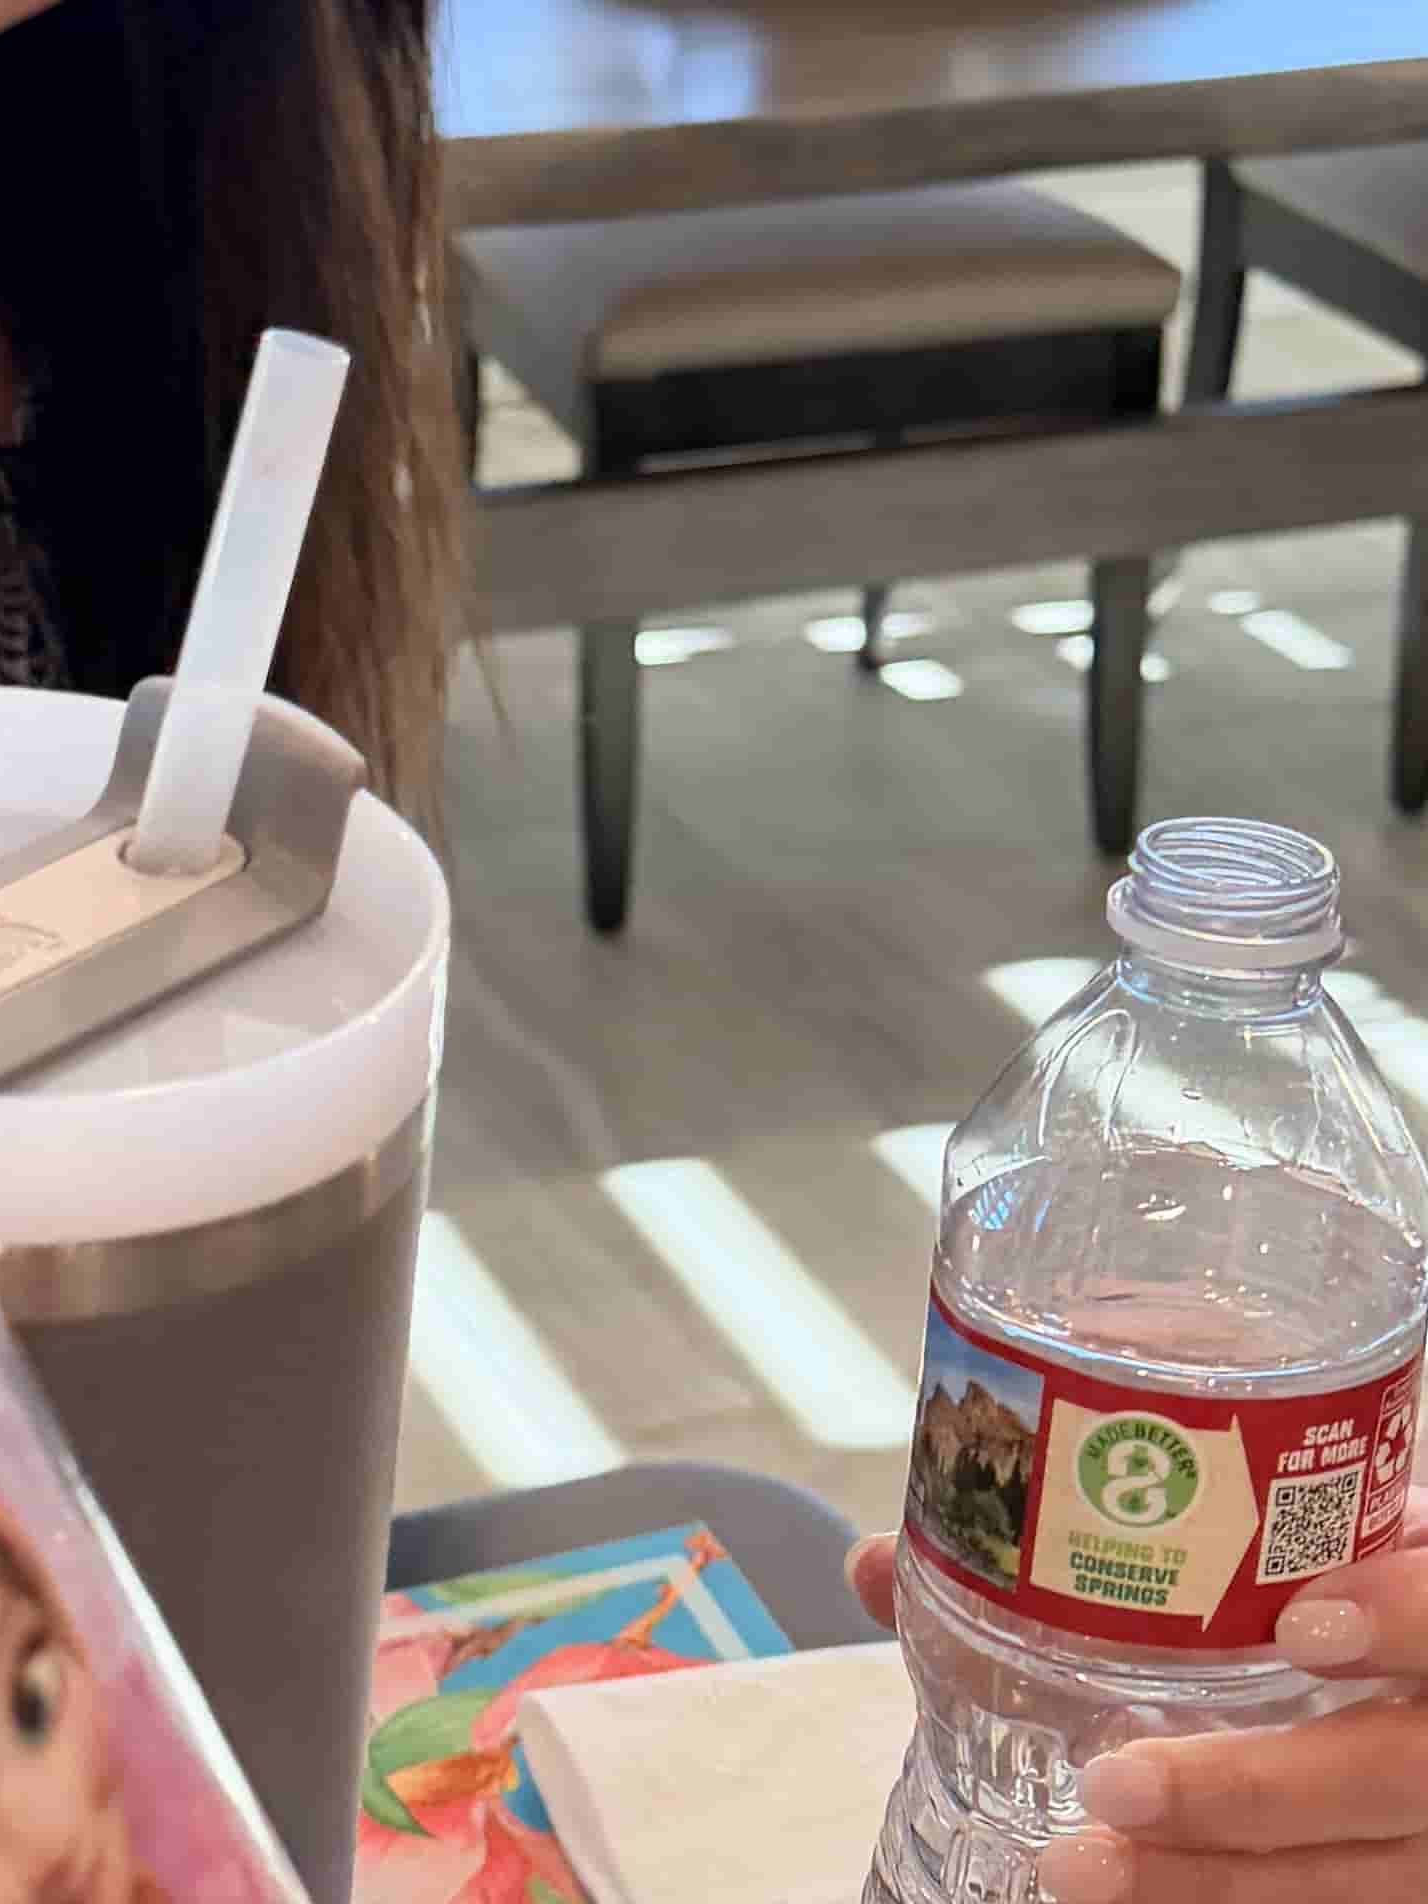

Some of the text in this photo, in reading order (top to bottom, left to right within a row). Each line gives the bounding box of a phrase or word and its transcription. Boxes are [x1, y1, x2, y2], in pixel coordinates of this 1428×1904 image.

[1304, 1418, 1355, 1446] SCAN
[1320, 1435, 1368, 1467] MORE
[1069, 1530, 1188, 1565] HELPING TO
[1069, 1551, 1180, 1586] CONSERVE
[1074, 1572, 1170, 1607] SPRINGS
